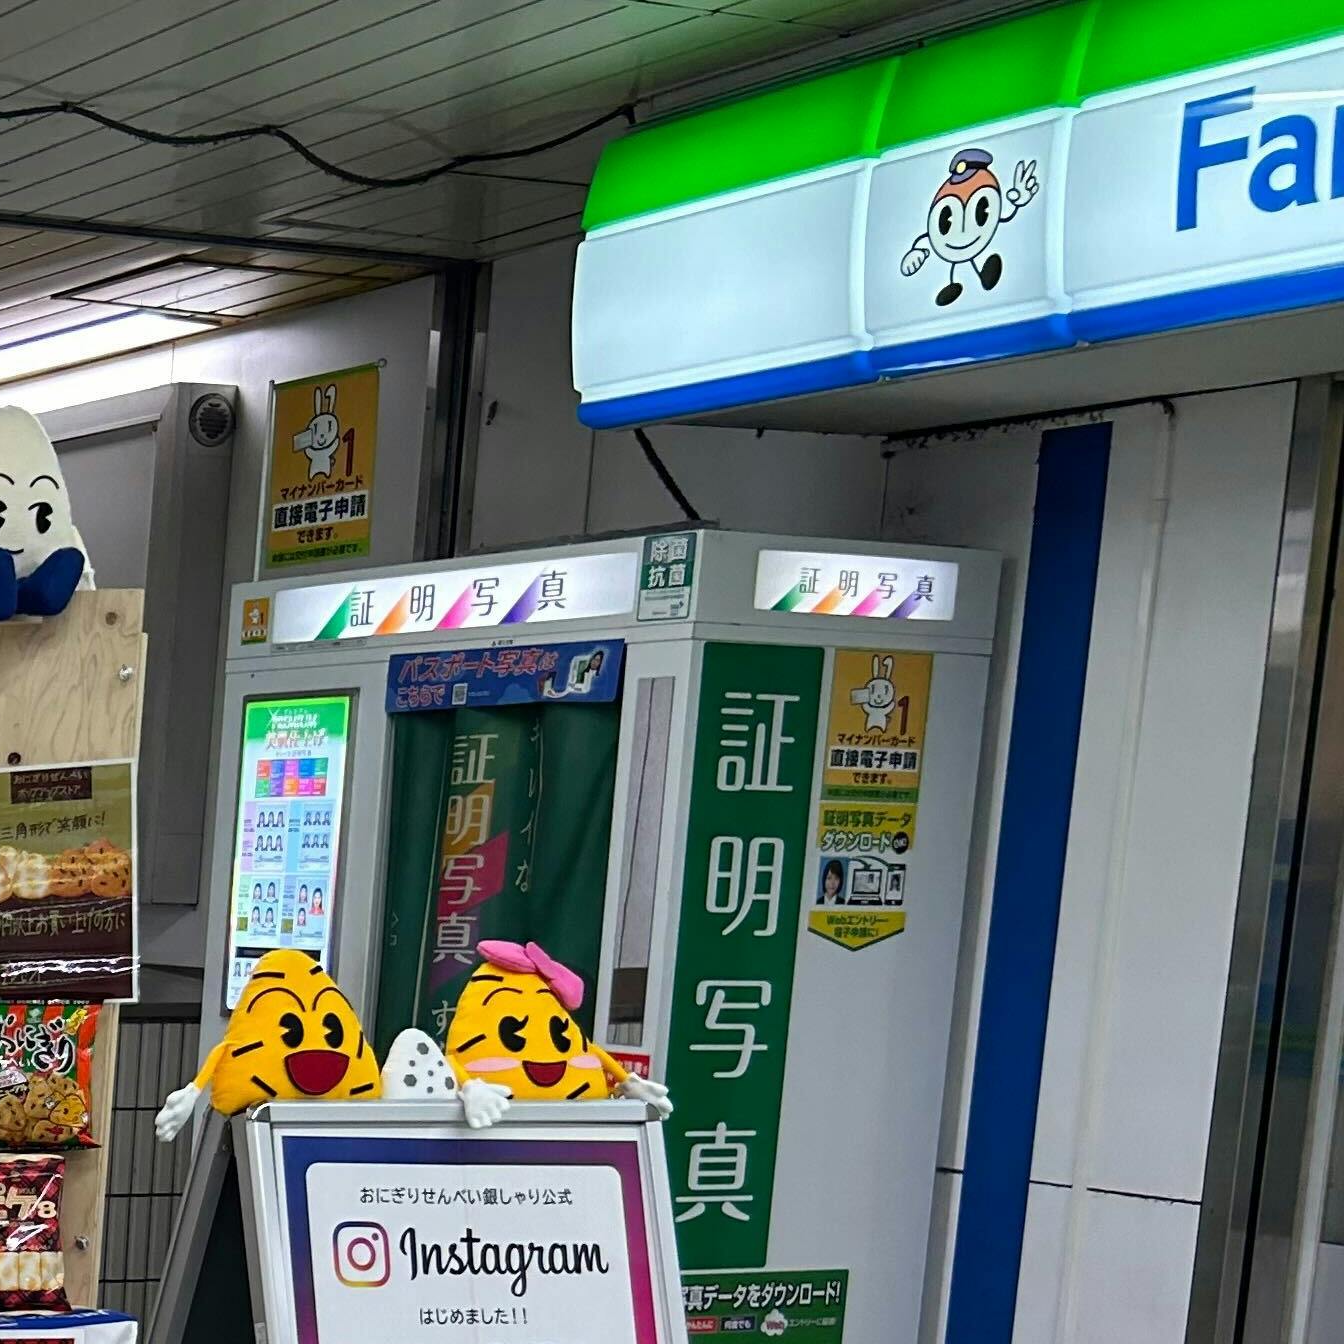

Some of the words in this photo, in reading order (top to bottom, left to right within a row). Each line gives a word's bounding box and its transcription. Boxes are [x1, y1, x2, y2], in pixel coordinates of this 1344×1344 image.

[1176, 85, 1344, 232] Fa
[280, 477, 364, 501] マイナンバーカード
[273, 494, 367, 530] 直接電子申請
[296, 527, 338, 543] できます。
[799, 566, 935, 602] 証明写真
[350, 569, 568, 627] 証明写真
[837, 733, 916, 748] マイナンバーカード
[830, 750, 917, 770] 直接電子申請
[0, 810, 106, 841] 三角形で笑顔に!
[823, 809, 912, 828] 証明写真データ
[431, 732, 500, 966] 証明写真
[821, 832, 892, 850] ダウンロード
[674, 691, 801, 1221] 証明写真
[359, 1187, 574, 1206] おにぎりせんべい銀しゃり公式
[399, 1227, 610, 1297] Instagram
[419, 1307, 528, 1325] はじめました!!
